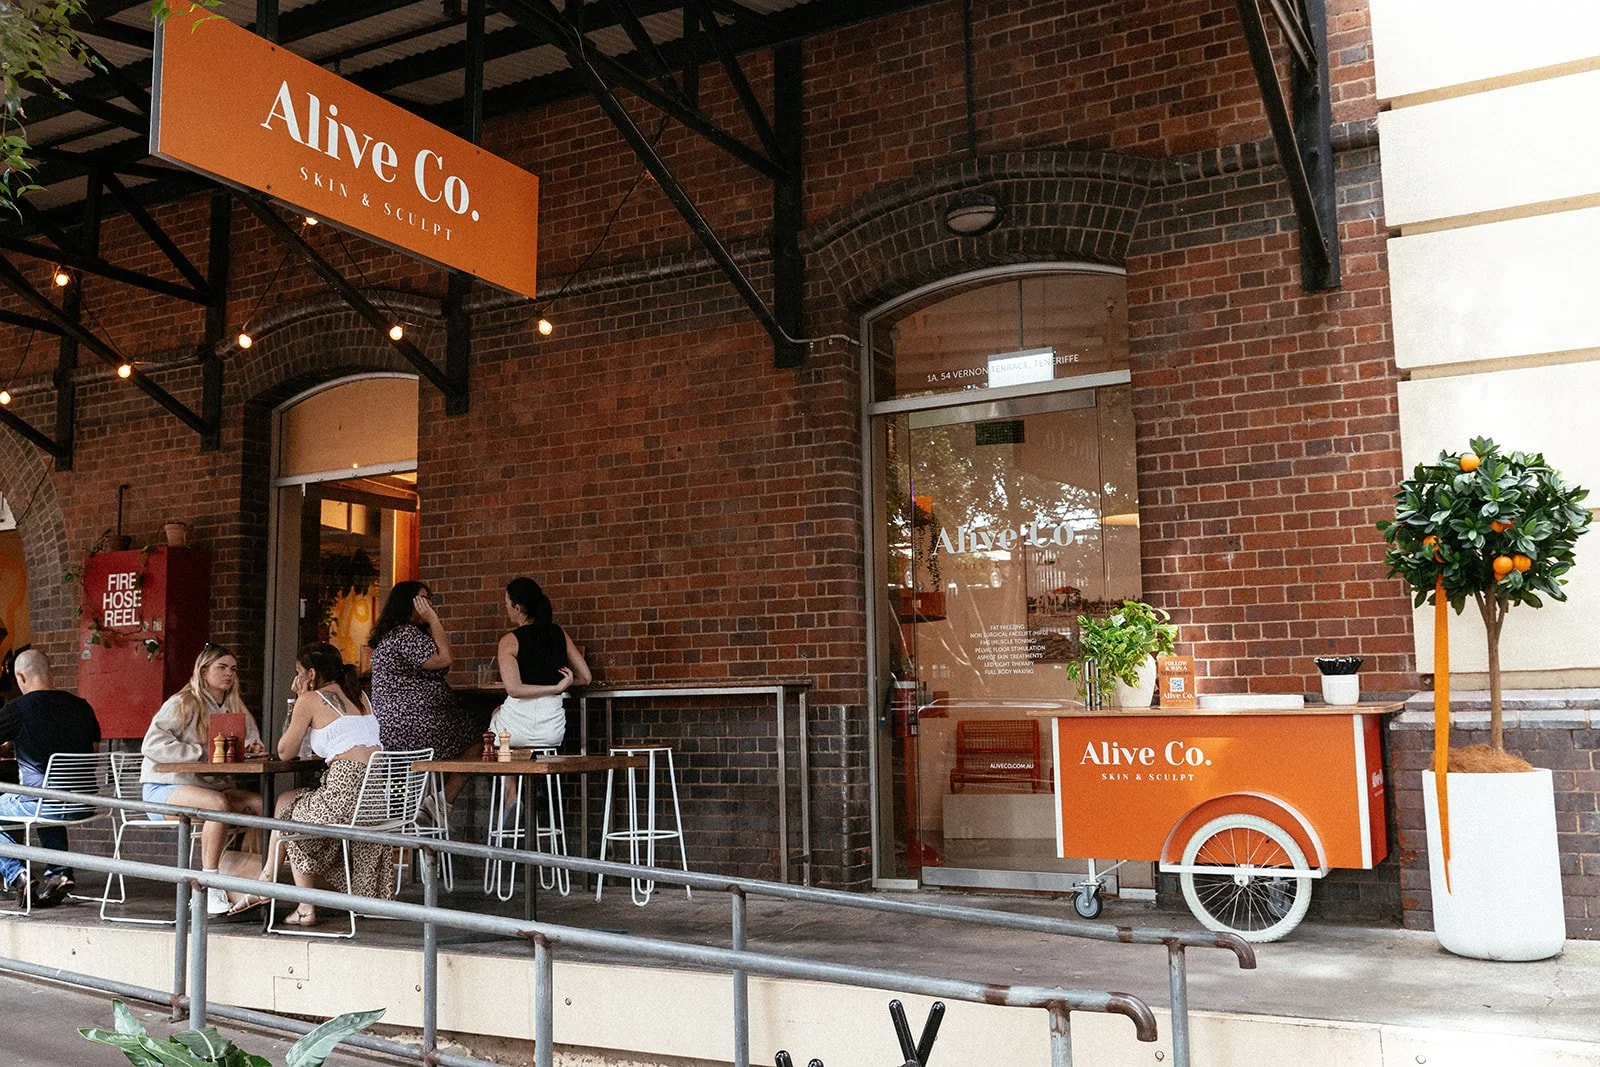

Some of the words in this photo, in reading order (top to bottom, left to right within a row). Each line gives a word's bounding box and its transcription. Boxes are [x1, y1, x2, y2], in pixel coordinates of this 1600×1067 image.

[260, 80, 398, 183] Alive
[414, 149, 480, 222] Co.
[300, 166, 349, 198] SKIN
[361, 193, 370, 207] &
[383, 202, 453, 241] SCULPT
[940, 372, 951, 380] 54
[953, 367, 988, 379] VERNON
[1034, 353, 1080, 368] TENERIFFE
[932, 526, 1018, 556] Alive
[108, 572, 137, 592] FIRE
[102, 590, 142, 610] HOSE
[104, 608, 140, 627] REEL
[1080, 741, 1155, 766] Alive
[1164, 740, 1212, 766] Co.
